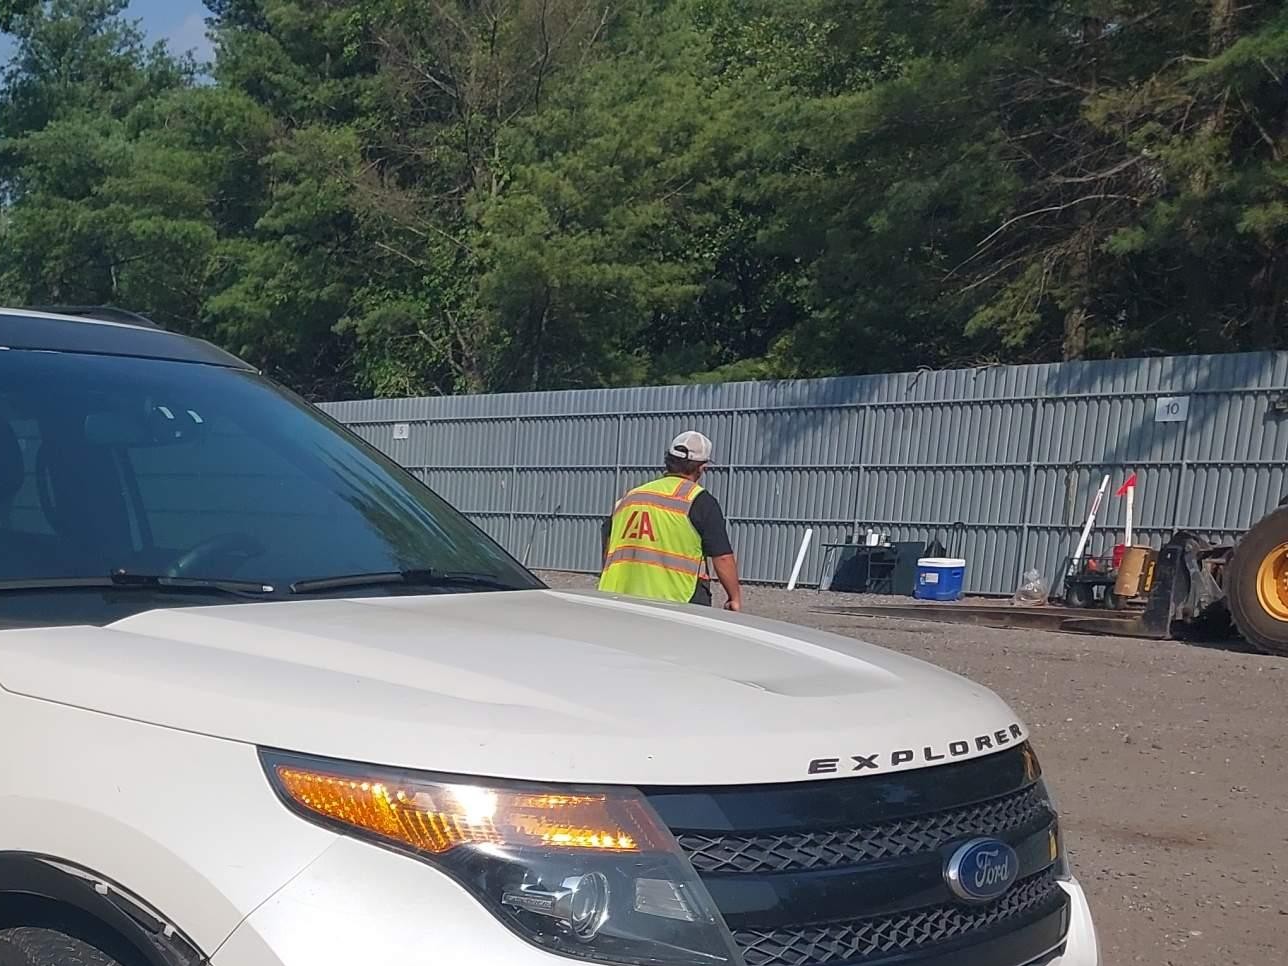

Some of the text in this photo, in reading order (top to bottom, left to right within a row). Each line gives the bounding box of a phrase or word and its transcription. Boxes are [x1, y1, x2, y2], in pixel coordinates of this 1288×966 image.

[1166, 402, 1180, 416] 10
[808, 723, 1022, 775] EXPLORER
[975, 850, 1011, 889] Ford
